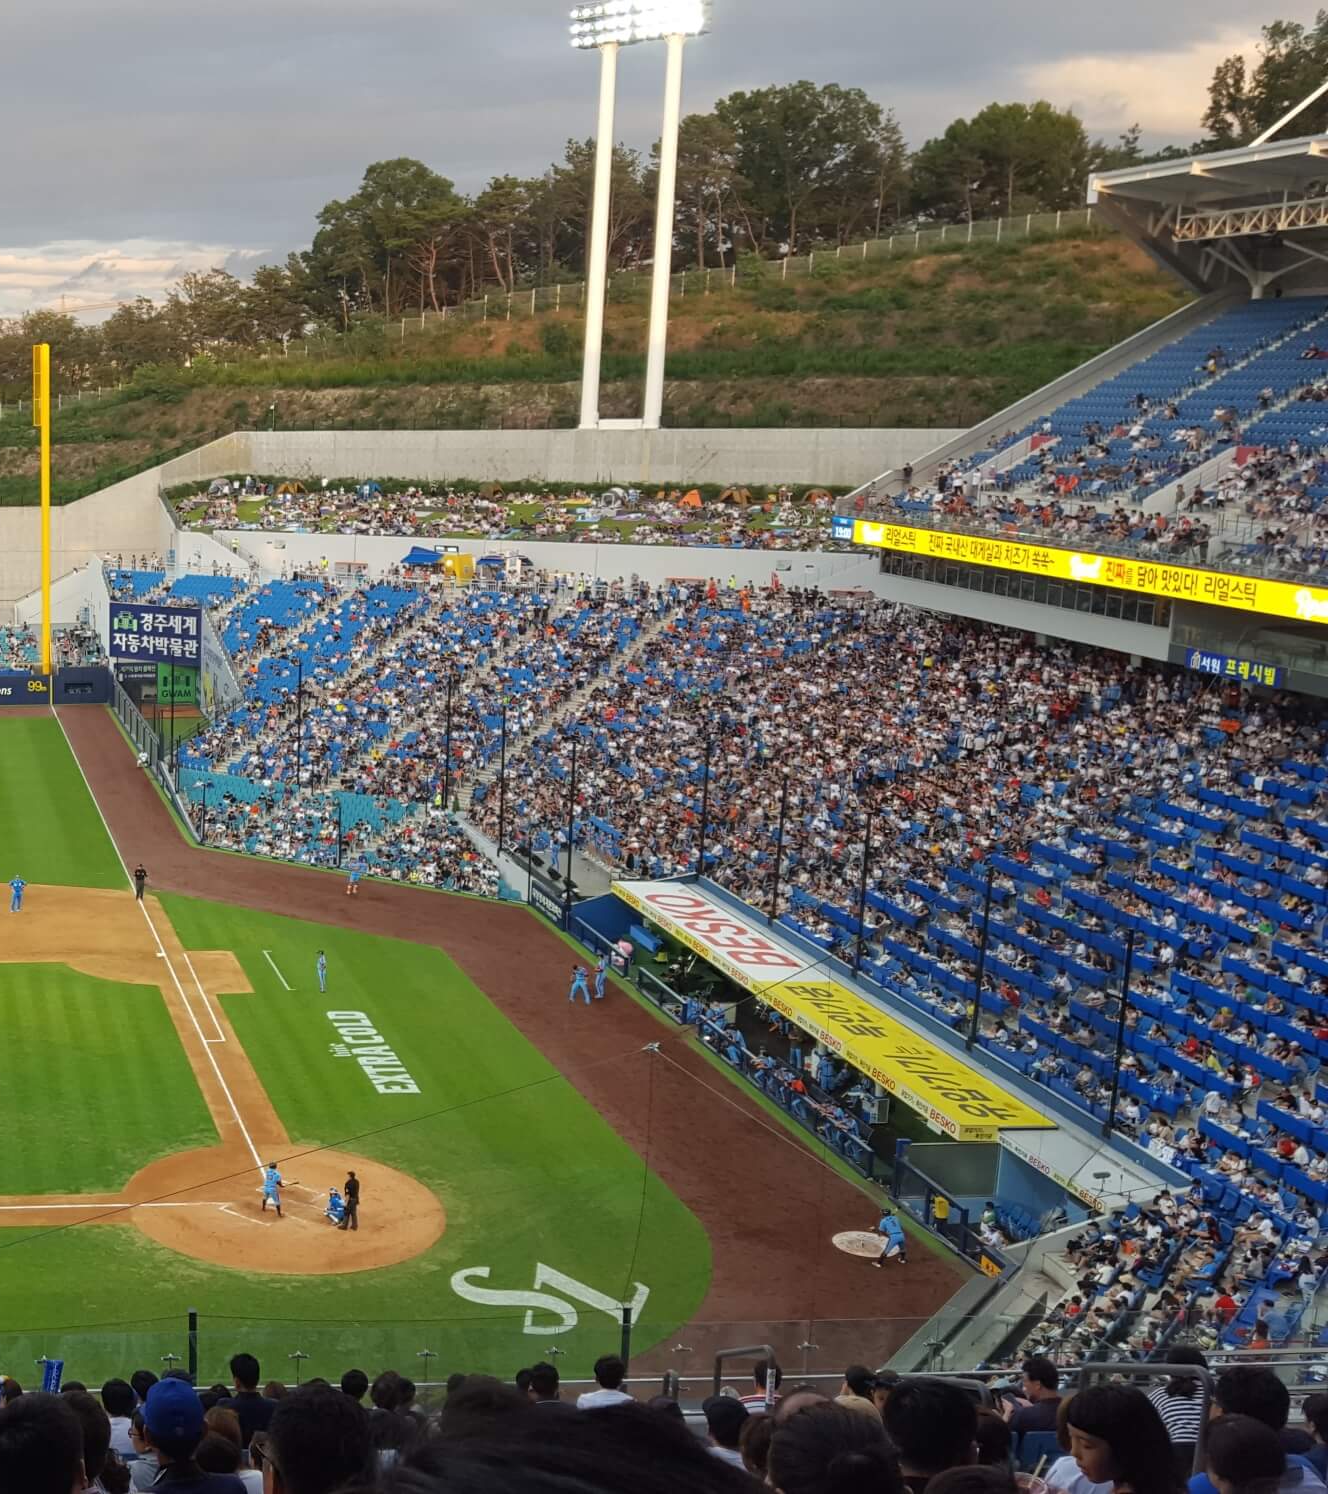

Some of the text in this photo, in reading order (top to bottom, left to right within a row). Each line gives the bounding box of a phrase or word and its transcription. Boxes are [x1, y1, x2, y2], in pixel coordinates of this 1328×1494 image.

[885, 527, 917, 549] 리얼스틱
[946, 537, 968, 556] 국내산
[970, 540, 1002, 562] 대게살과
[1004, 545, 1030, 567] 치즈가
[1137, 566, 1158, 588] 담아
[1161, 569, 1198, 597] 맛있다!
[1204, 575, 1257, 607] 리얼스틱
[140, 613, 198, 636] 경주세계
[113, 633, 200, 659] 자동차박물관
[1201, 656, 1276, 686] 서원 프레시빌
[645, 894, 802, 968] BESKO
[773, 997, 793, 1017] BESKO
[327, 1010, 421, 1094] EXTRA COLD
[820, 1030, 842, 1052] BESKO
[871, 1067, 896, 1090] BESKO
[884, 1046, 1020, 1121] 유압기기는
[929, 1108, 957, 1134] BESKO
[1027, 1154, 1051, 1175] BESKO
[1079, 1189, 1103, 1212] BESKO
